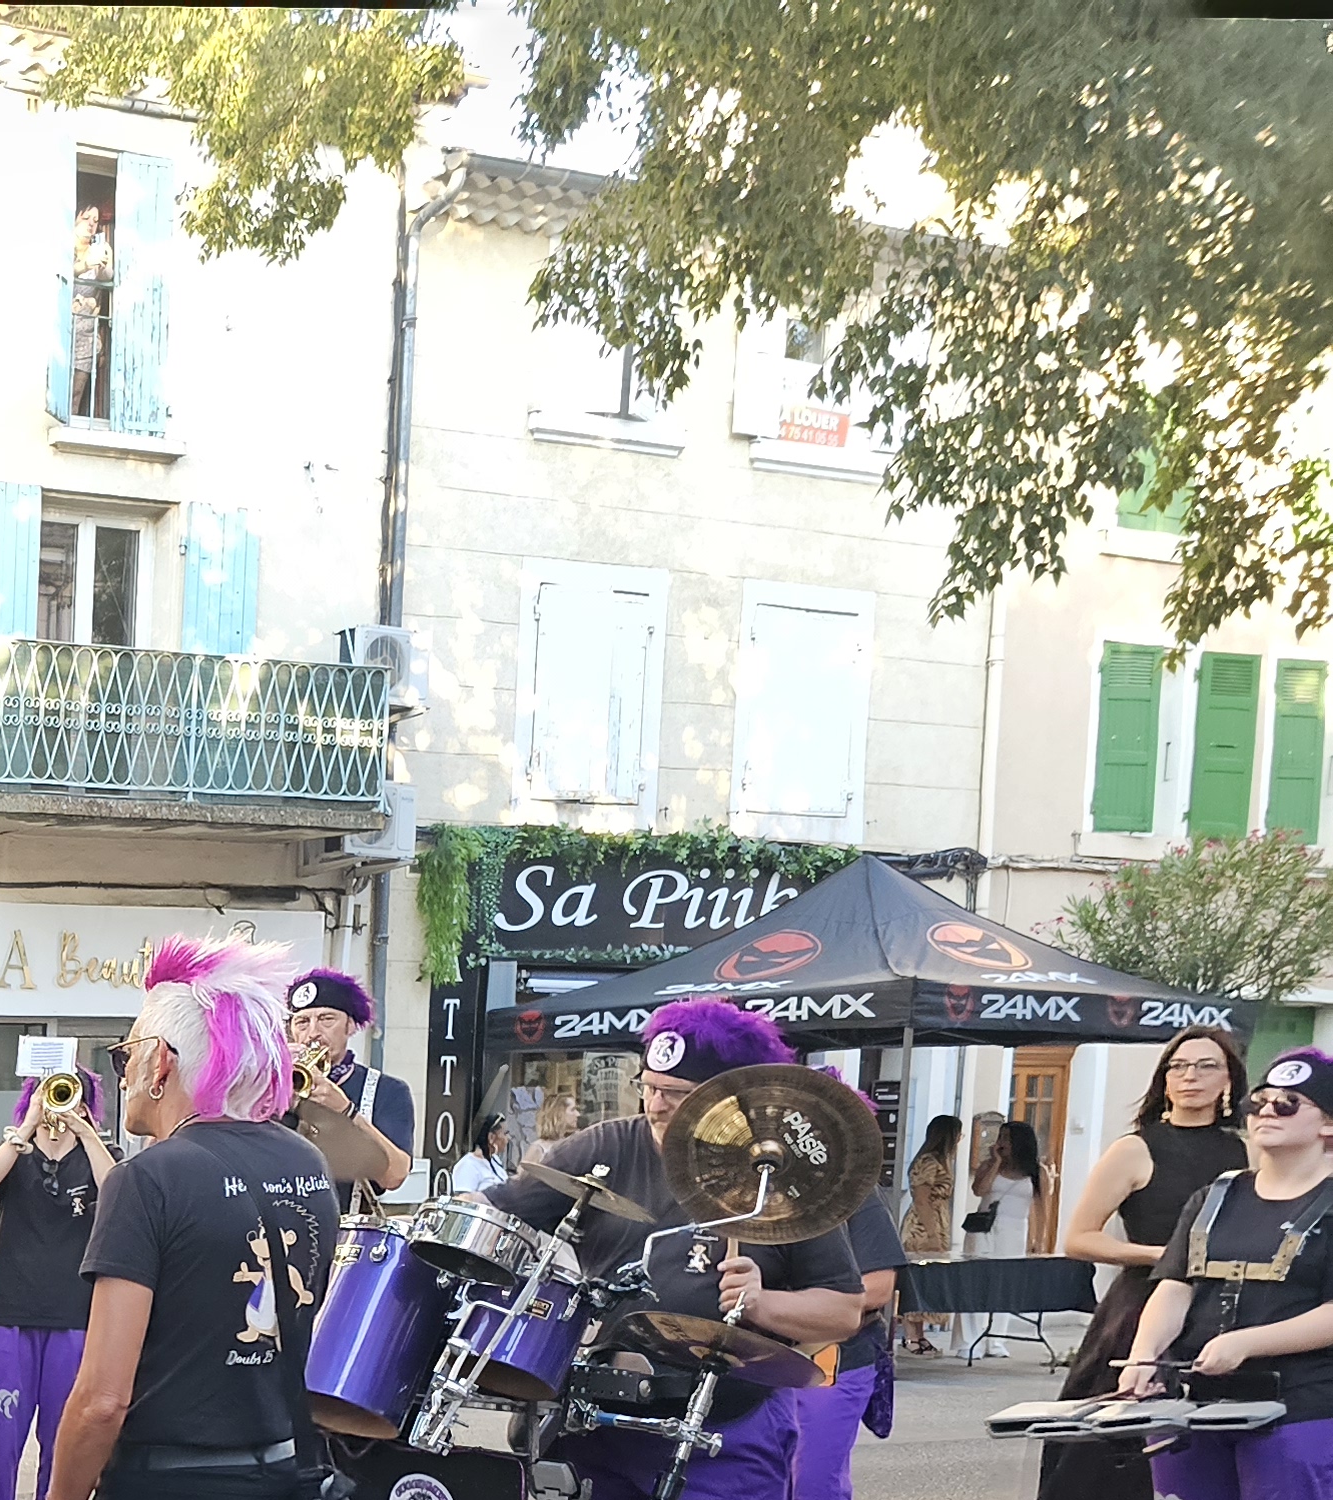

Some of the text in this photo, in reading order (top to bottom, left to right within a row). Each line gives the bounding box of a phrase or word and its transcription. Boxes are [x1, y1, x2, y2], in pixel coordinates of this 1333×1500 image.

[794, 408, 839, 432] LOUER
[494, 864, 598, 933] Sa
[55, 928, 155, 990] Beaut
[980, 994, 1082, 1022] 24MX
[1139, 1001, 1234, 1032] 24MX
[225, 1350, 262, 1367] Doubs
